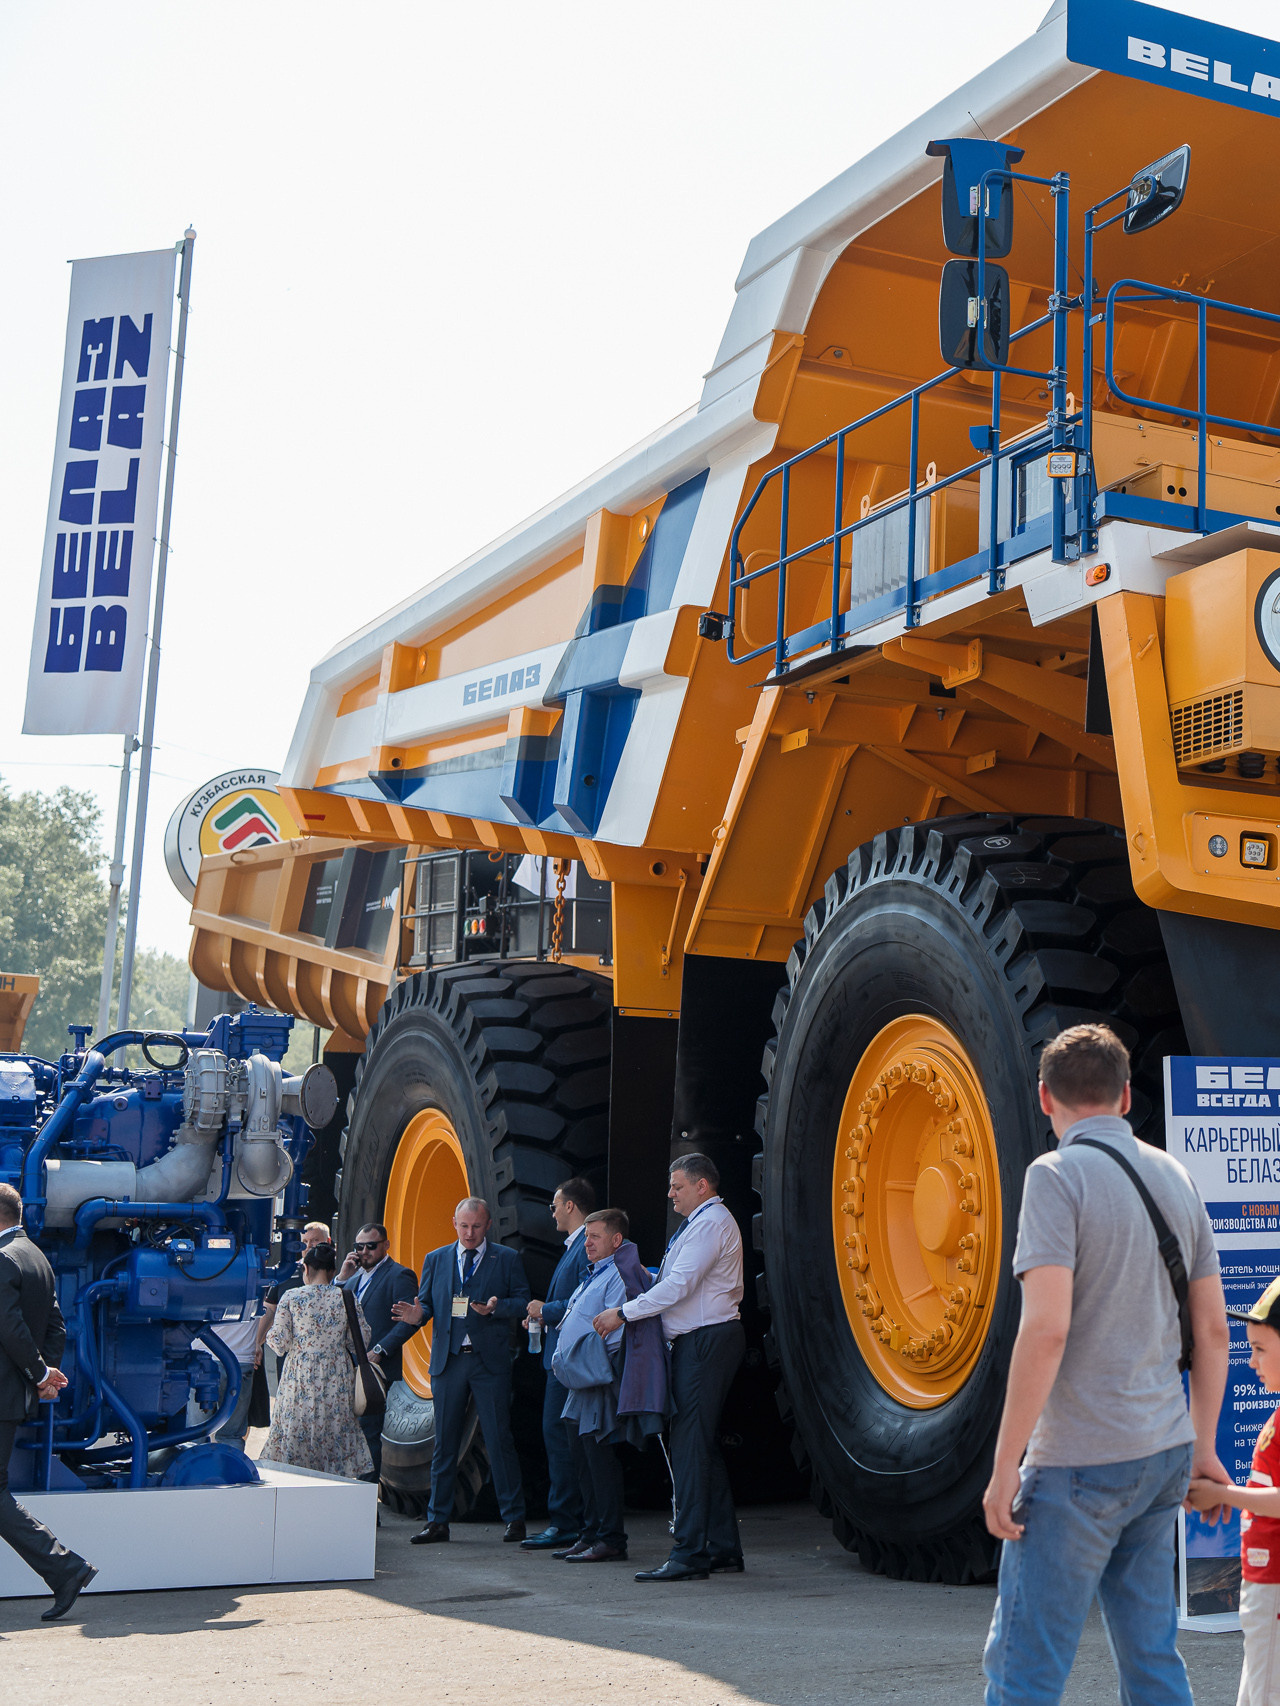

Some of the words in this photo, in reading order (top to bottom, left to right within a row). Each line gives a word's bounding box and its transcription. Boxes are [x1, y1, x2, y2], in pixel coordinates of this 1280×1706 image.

[44, 315, 115, 673] БЕЛАЗ
[85, 312, 154, 672] BELAZ
[462, 661, 542, 707] БЕЛАЗ
[190, 774, 266, 818] КУЗБАССКАЯ
[1196, 1093, 1271, 1108] ВСЕГДА
[1242, 1204, 1248, 1217] С
[1249, 1204, 1280, 1217] НОВЫМ
[1210, 1217, 1266, 1231] РОИЗВОДСТВА
[1267, 1217, 1278, 1229] АО
[1220, 1265, 1253, 1275] игатель
[1221, 1282, 1255, 1290] личенный
[1226, 1303, 1255, 1312] окопр
[1233, 1384, 1257, 1397] 99%
[1234, 1422, 1264, 1433] Сниже
[1234, 1438, 1246, 1448] на
[1247, 1438, 1258, 1447] те
